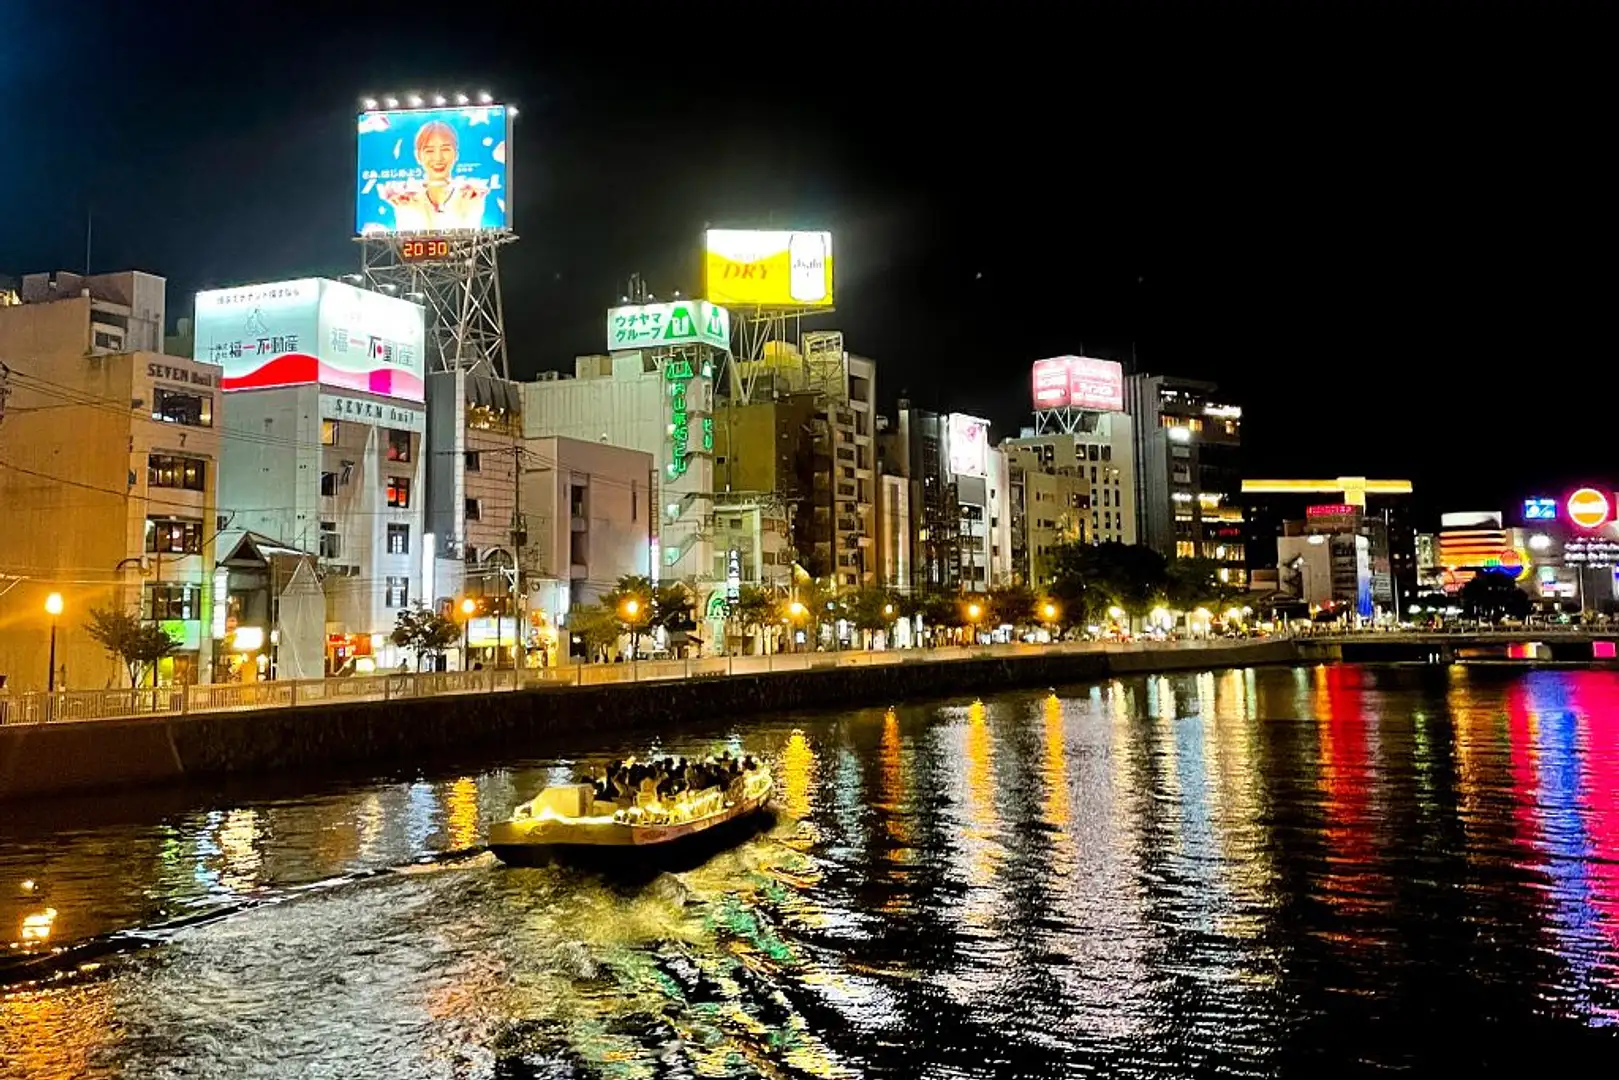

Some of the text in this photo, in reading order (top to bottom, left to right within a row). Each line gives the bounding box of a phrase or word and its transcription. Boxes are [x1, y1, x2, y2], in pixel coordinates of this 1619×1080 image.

[723, 262, 769, 279] DRY
[615, 312, 662, 327] ウチヤマ
[615, 326, 662, 342] グループ
[147, 363, 189, 382] SEVEN
[335, 399, 383, 418] SEVEN
